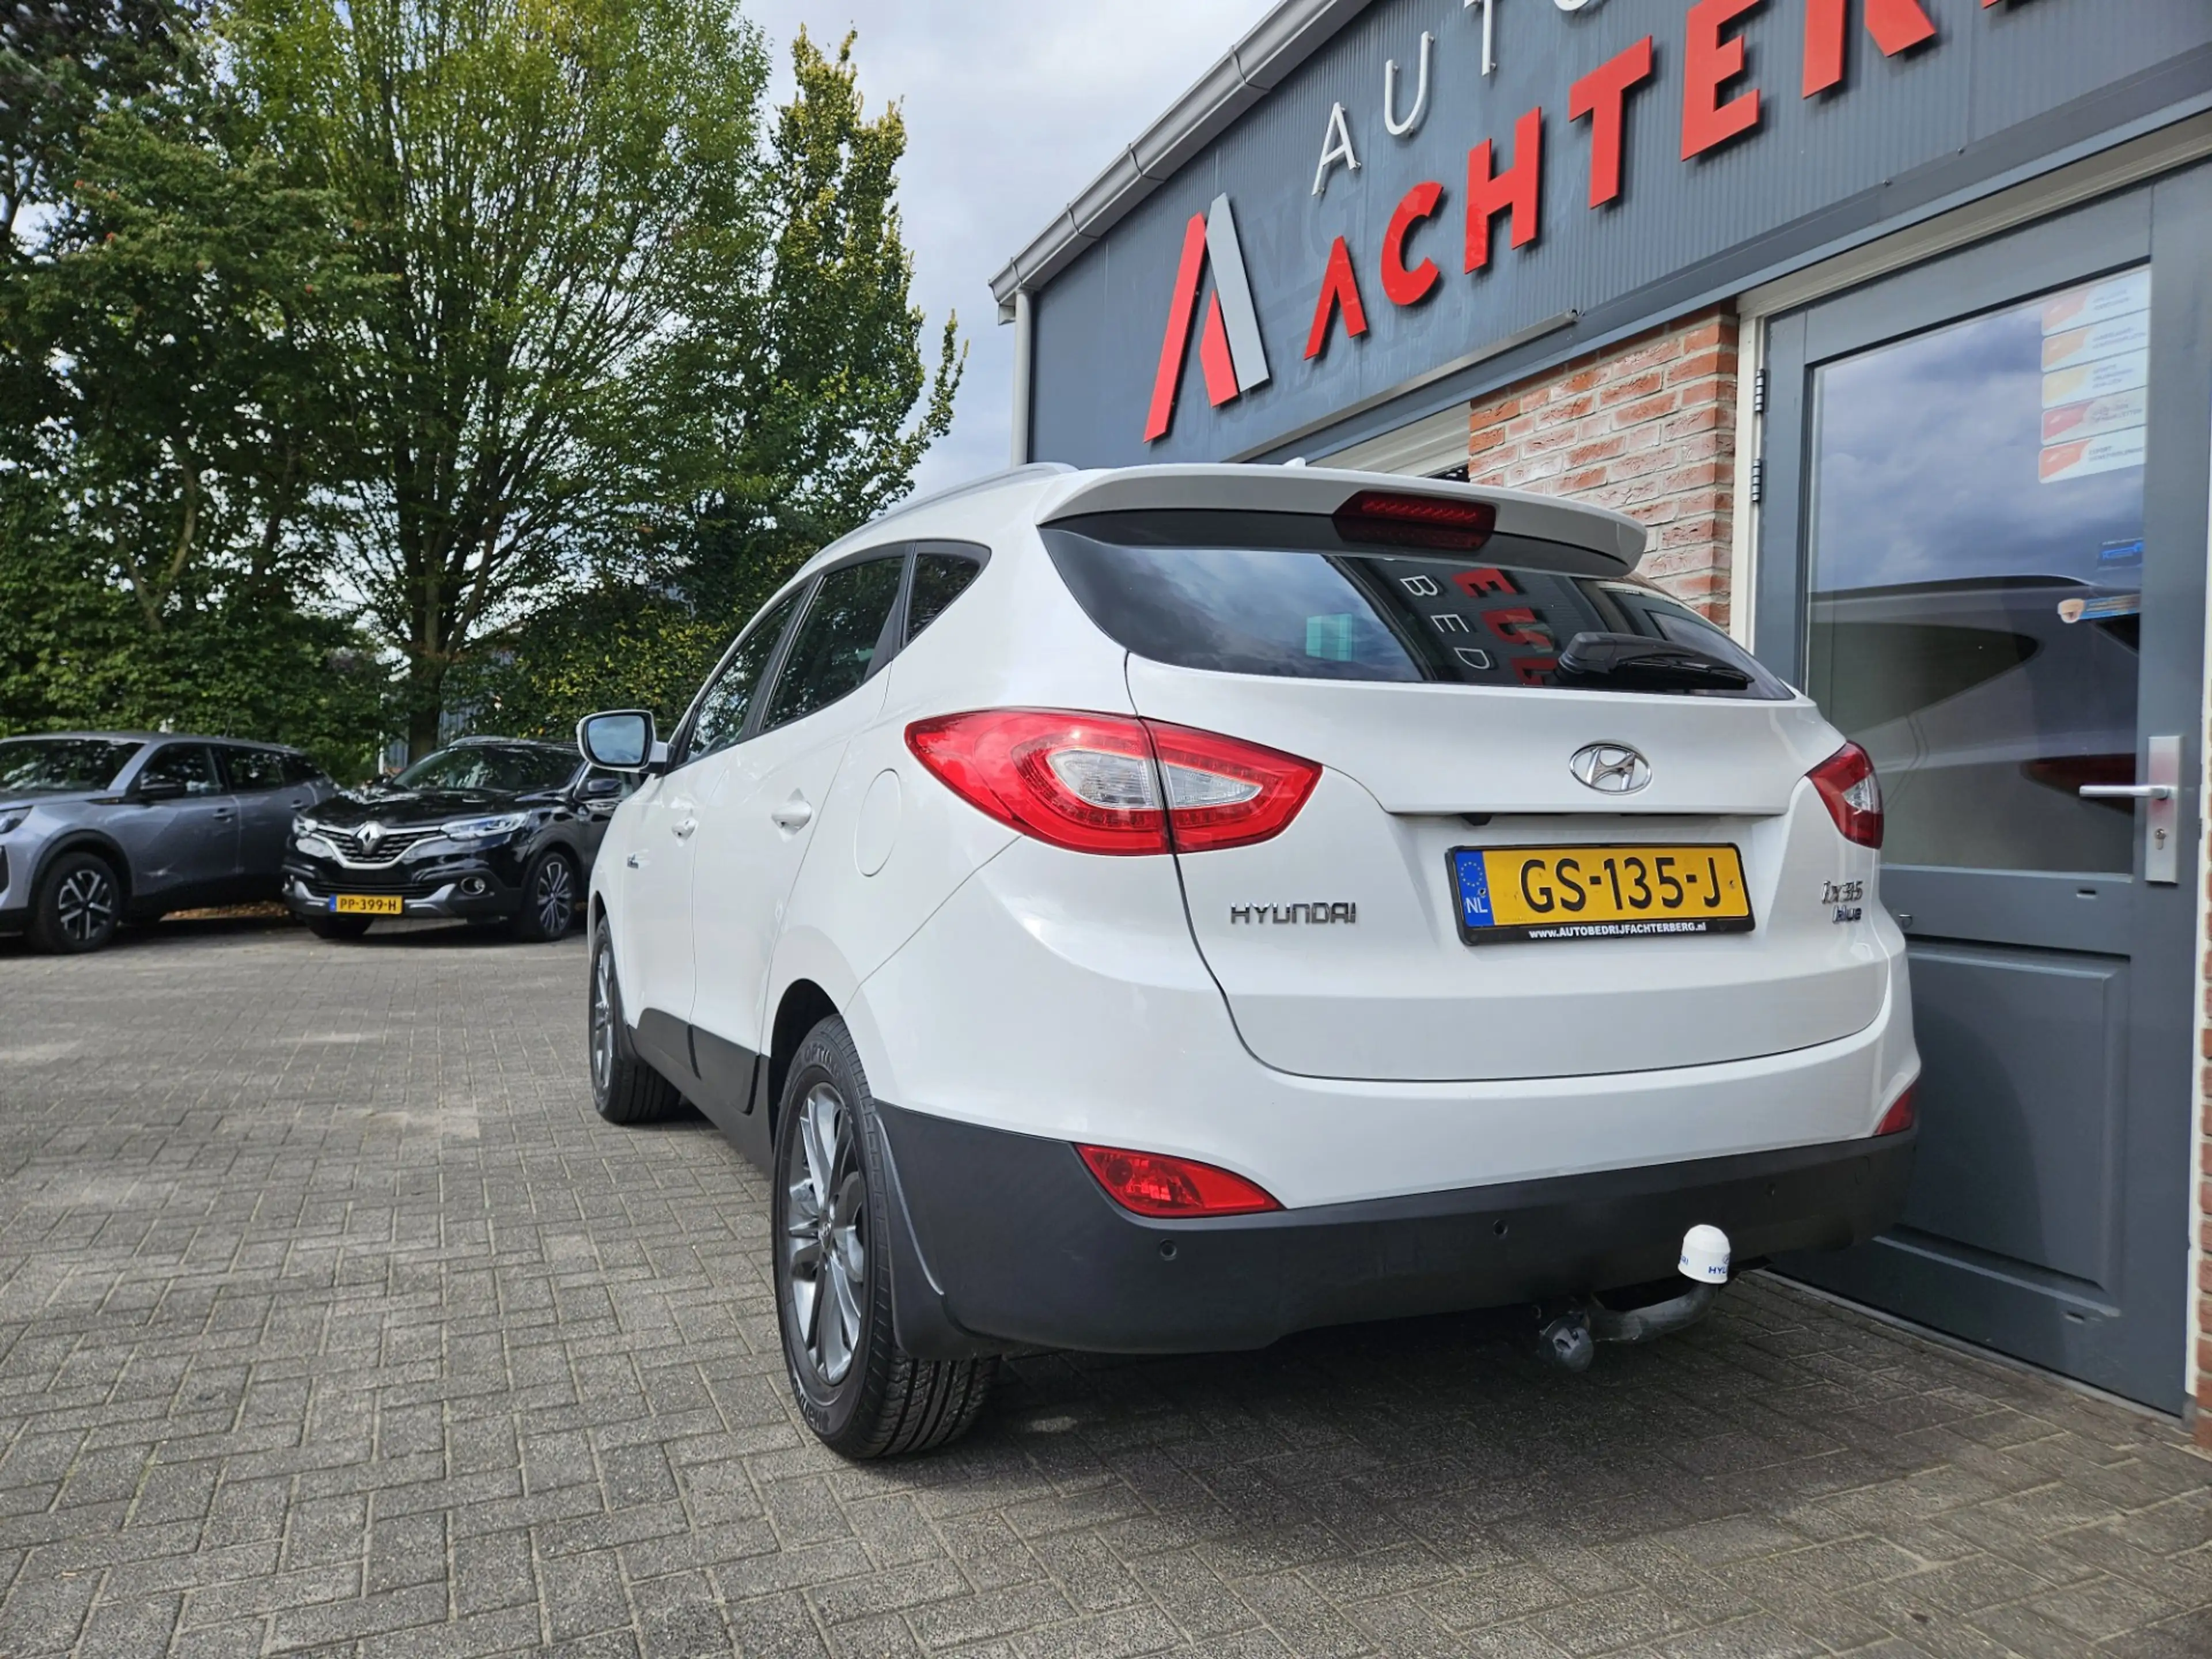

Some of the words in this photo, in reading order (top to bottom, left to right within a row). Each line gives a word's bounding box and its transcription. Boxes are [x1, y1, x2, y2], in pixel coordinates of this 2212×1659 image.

[1465, 896, 1488, 914] NL
[1521, 856, 1722, 914] GS-135-J
[339, 898, 396, 911] PP-399-H
[1230, 902, 1357, 925] HYUNDAI
[1528, 922, 1707, 939] www.AUTOBEDRIJFACHTERBERG.nl
